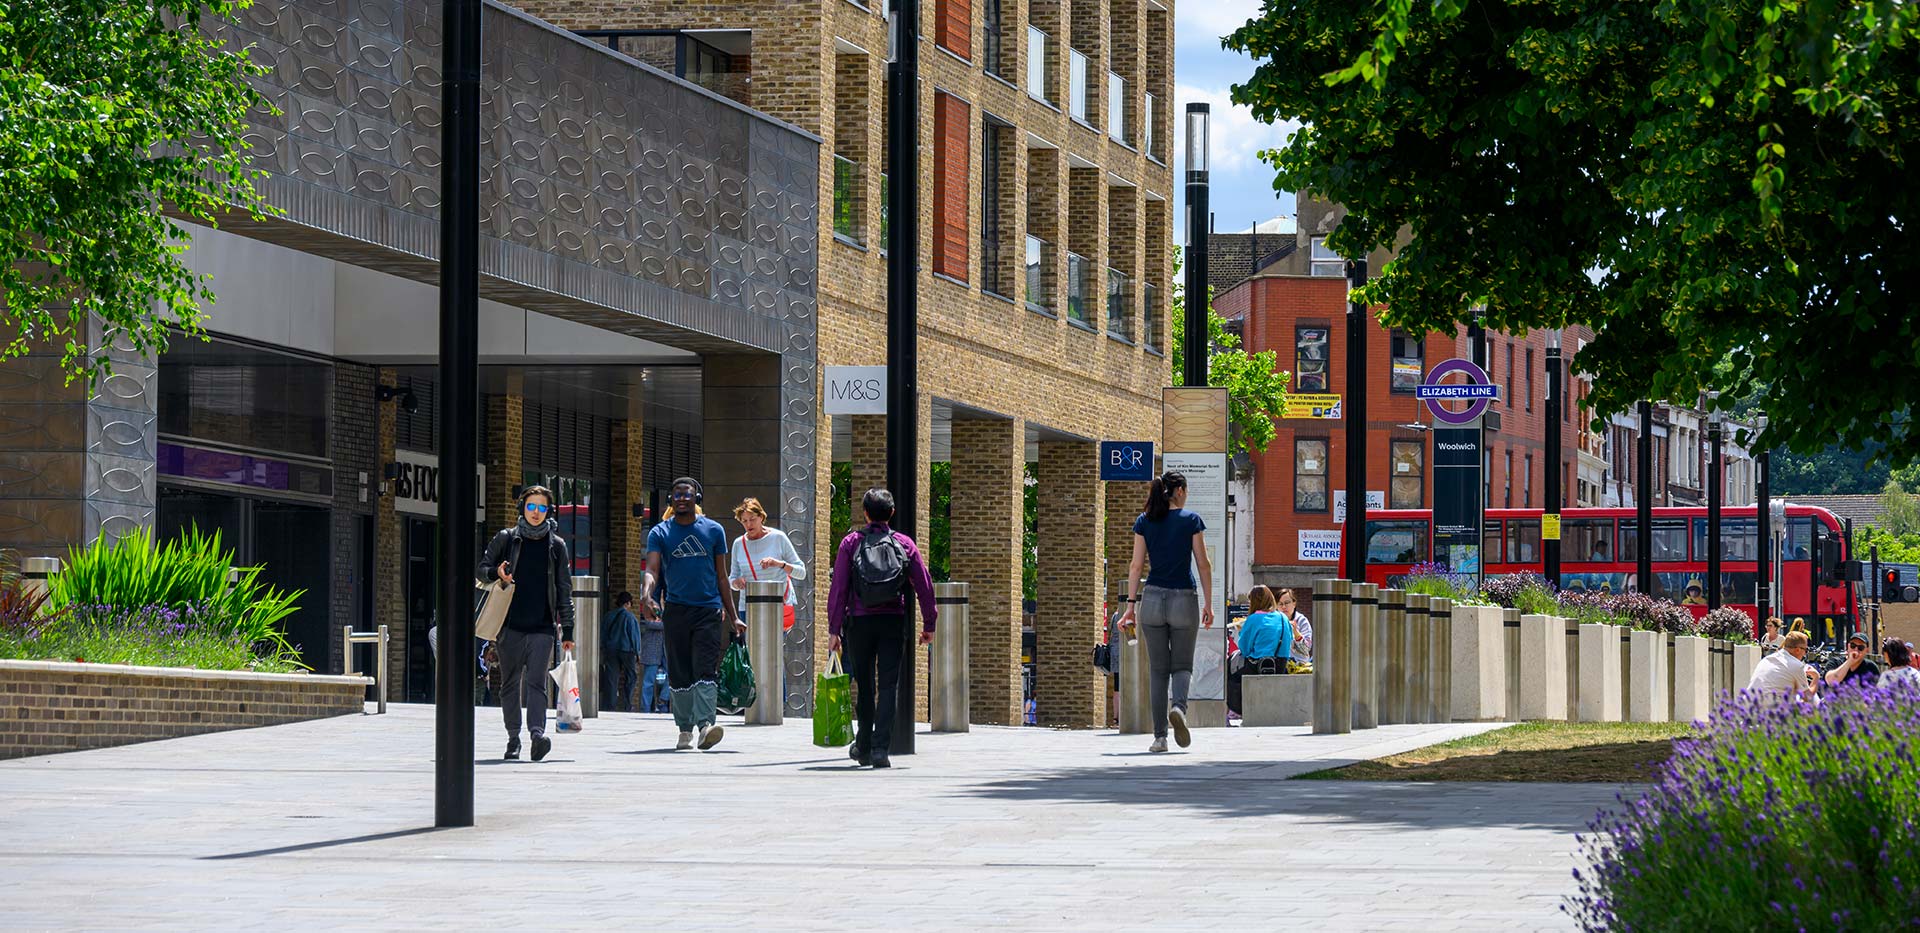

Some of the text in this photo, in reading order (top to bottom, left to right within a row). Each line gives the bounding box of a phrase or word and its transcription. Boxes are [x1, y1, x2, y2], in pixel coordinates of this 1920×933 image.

[831, 379, 881, 401] M&S
[1421, 387, 1492, 396] ELIZABETH LINE
[1111, 445, 1143, 470] B&R
